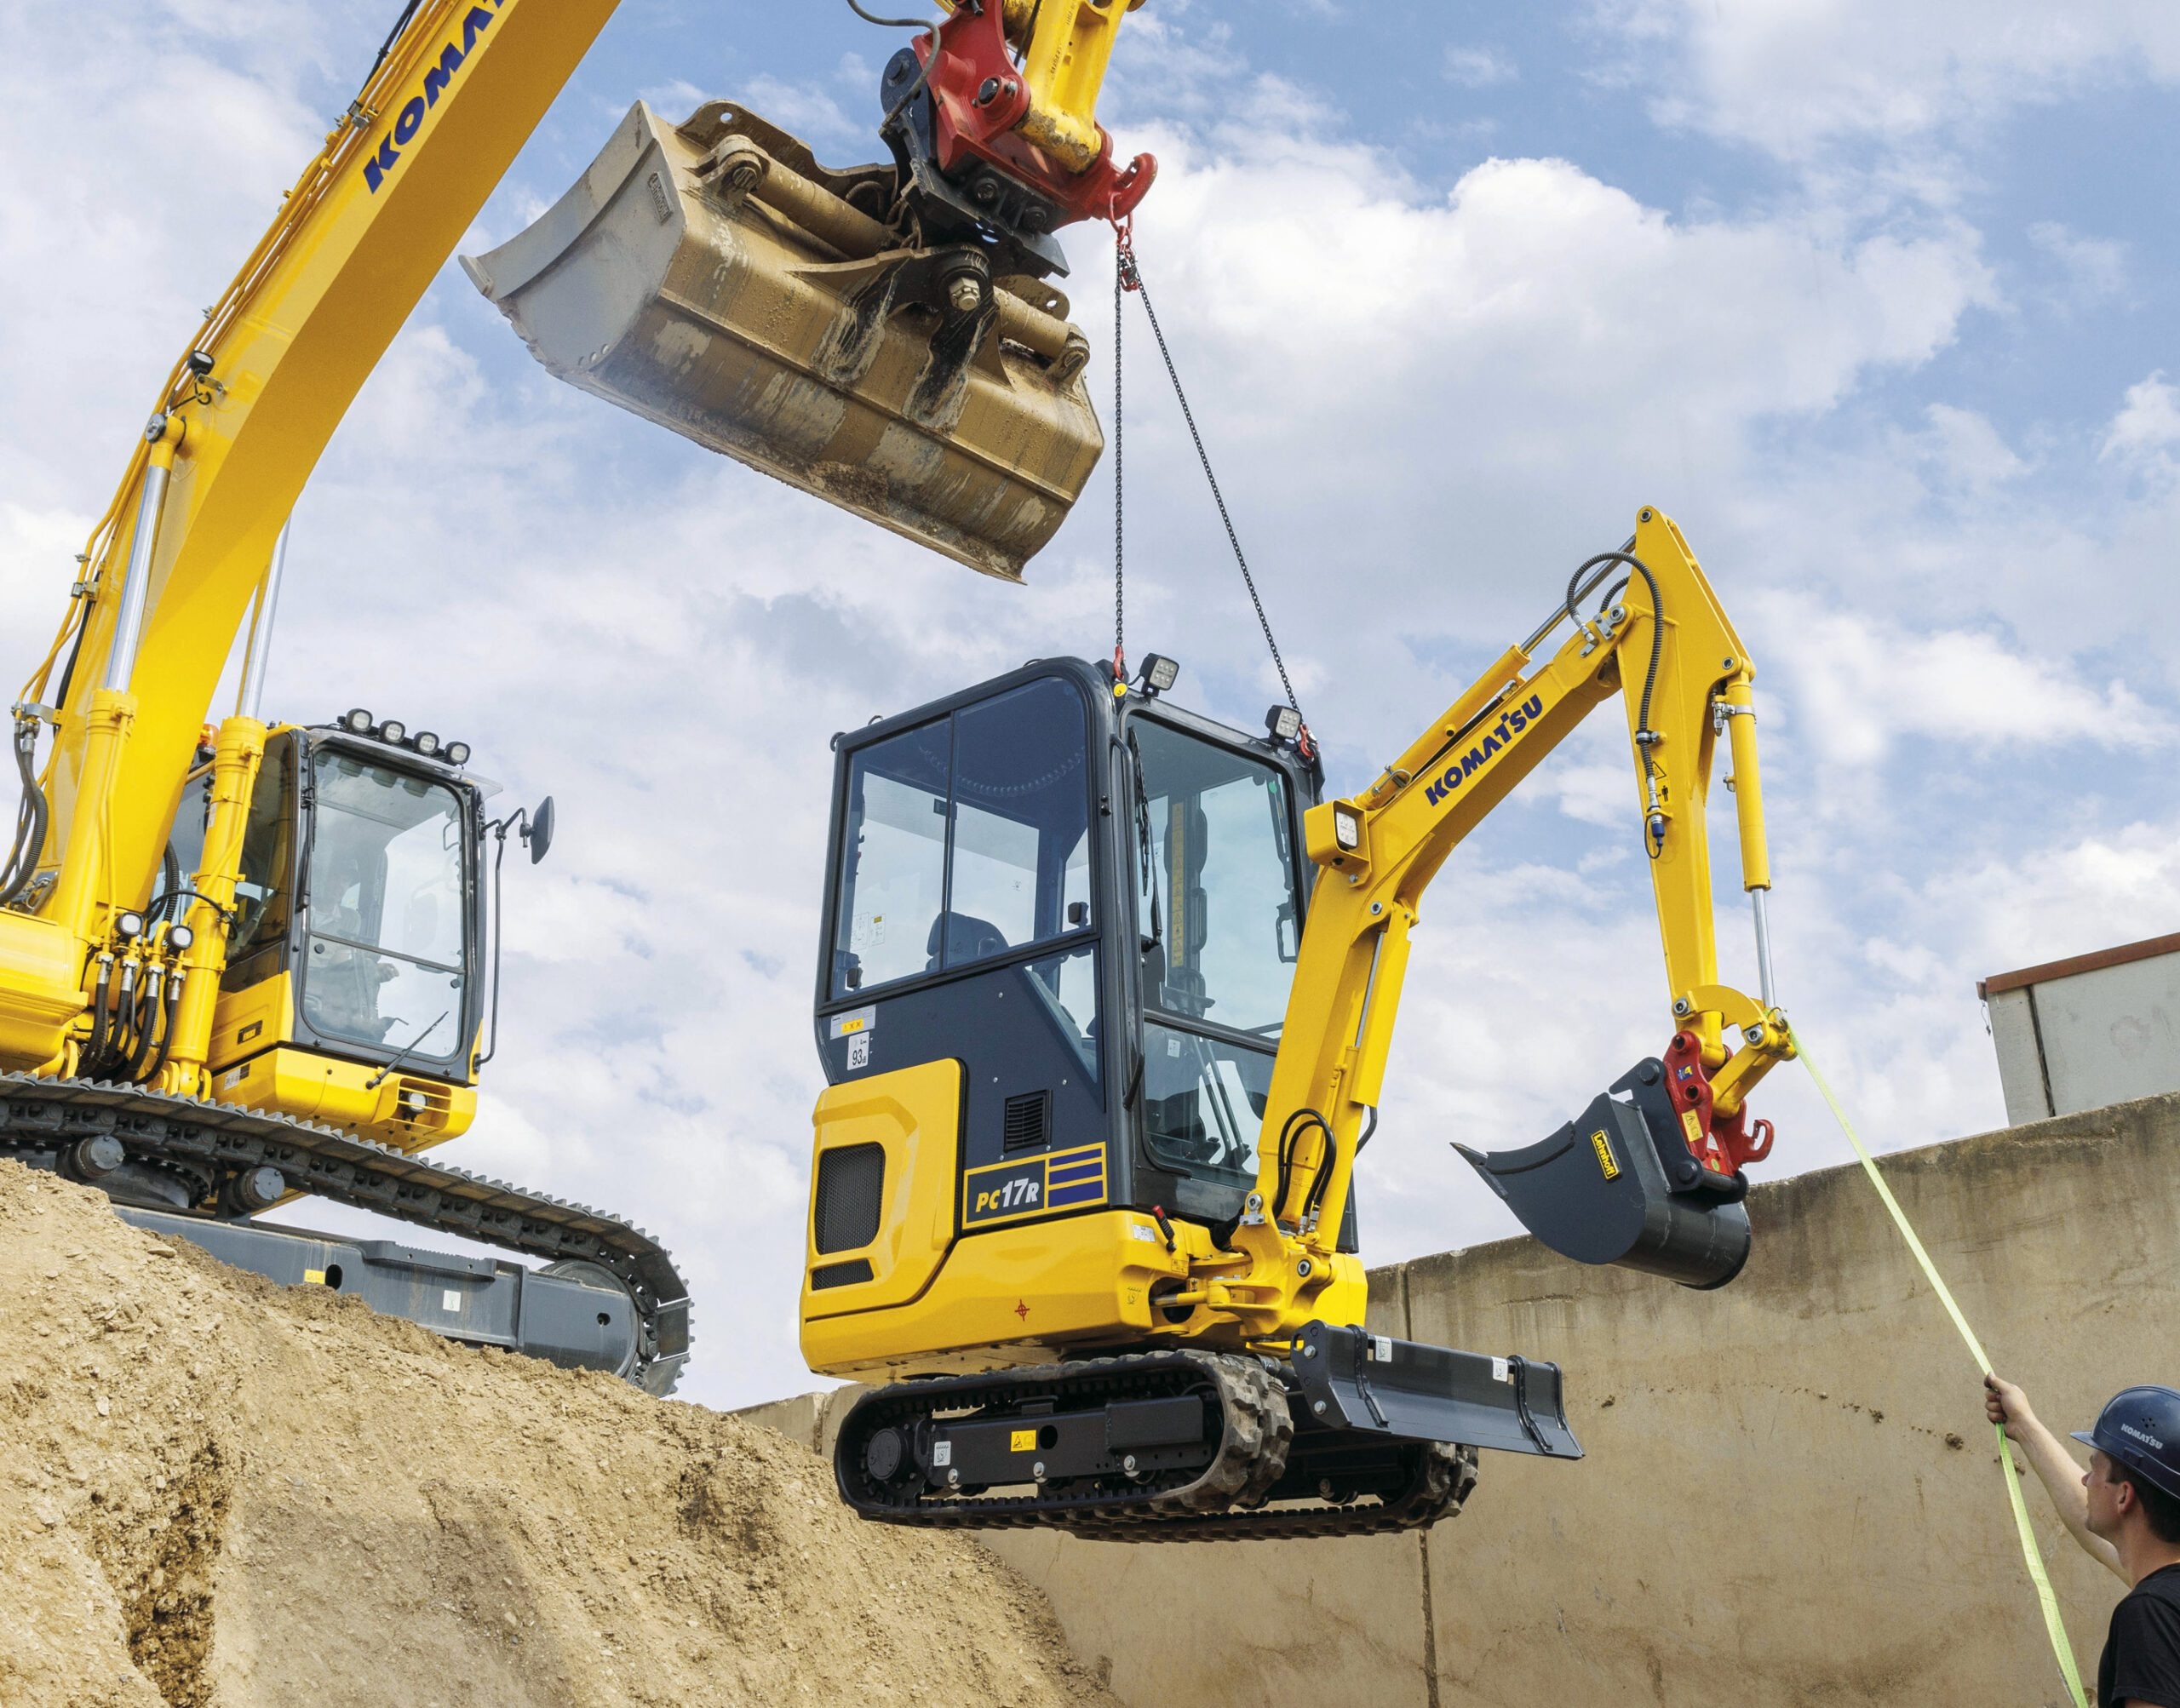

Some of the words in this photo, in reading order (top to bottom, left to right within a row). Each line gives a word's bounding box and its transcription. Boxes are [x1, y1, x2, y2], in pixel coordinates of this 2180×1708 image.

[363, 0, 504, 194] KOMA
[1425, 694, 1543, 806] KOMATSU
[852, 1048, 863, 1066] 93
[1593, 1132, 1615, 1176] Lehnhoff
[975, 1178, 1039, 1212] PC17R
[2121, 1423, 2163, 1450] KOMATSU
